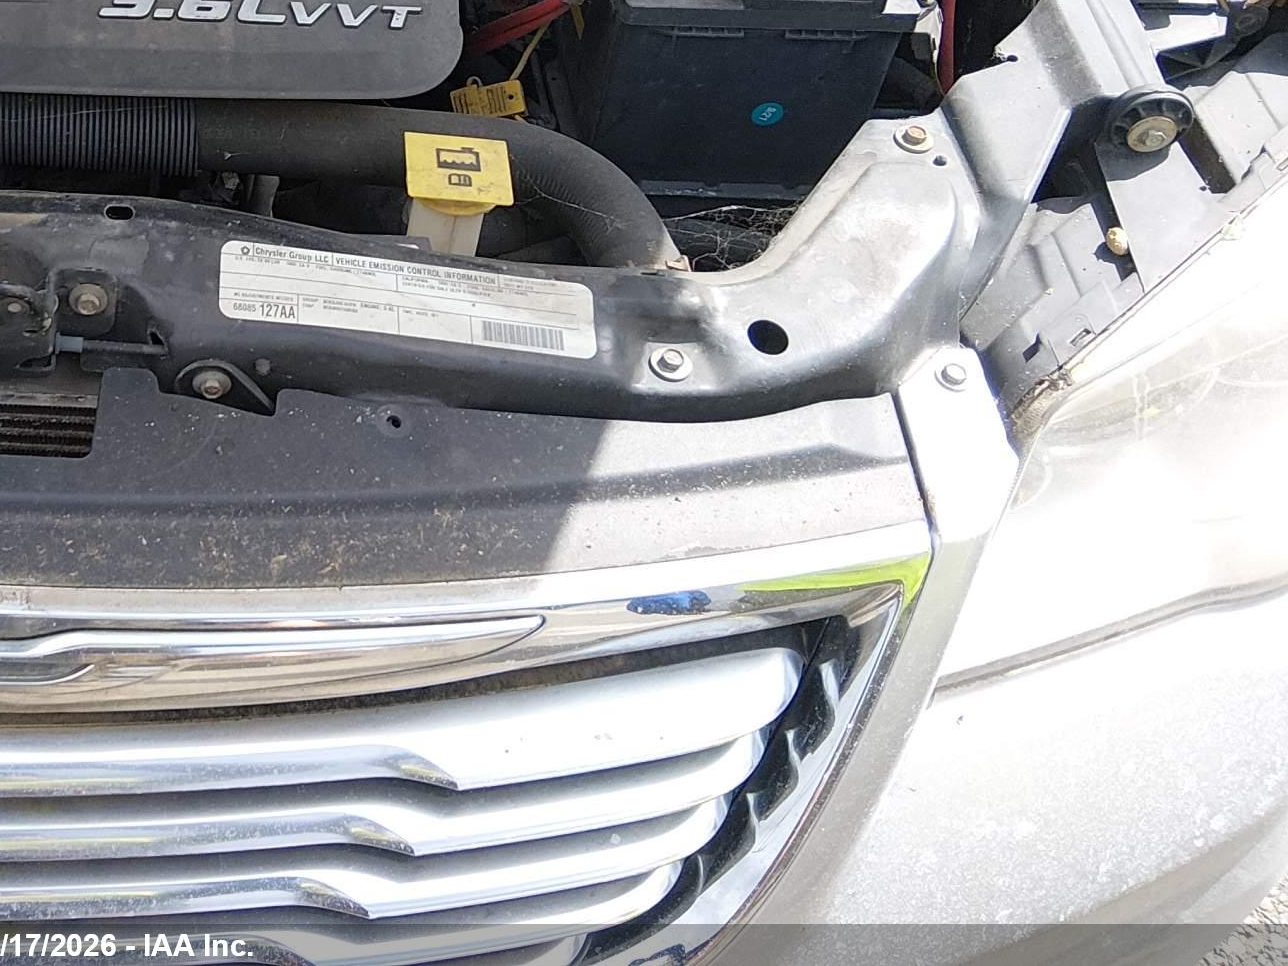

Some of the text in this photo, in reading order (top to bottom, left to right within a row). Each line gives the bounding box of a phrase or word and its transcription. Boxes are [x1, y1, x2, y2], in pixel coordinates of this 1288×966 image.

[255, 247, 287, 260] Chrysler
[289, 251, 312, 262] Group
[314, 255, 329, 264] LLC
[335, 257, 365, 268] VEHICLE
[369, 261, 404, 273] EMISSION
[407, 266, 440, 278] CONTROL
[444, 270, 496, 284] INFORMATION
[260, 303, 296, 319] 127AA
